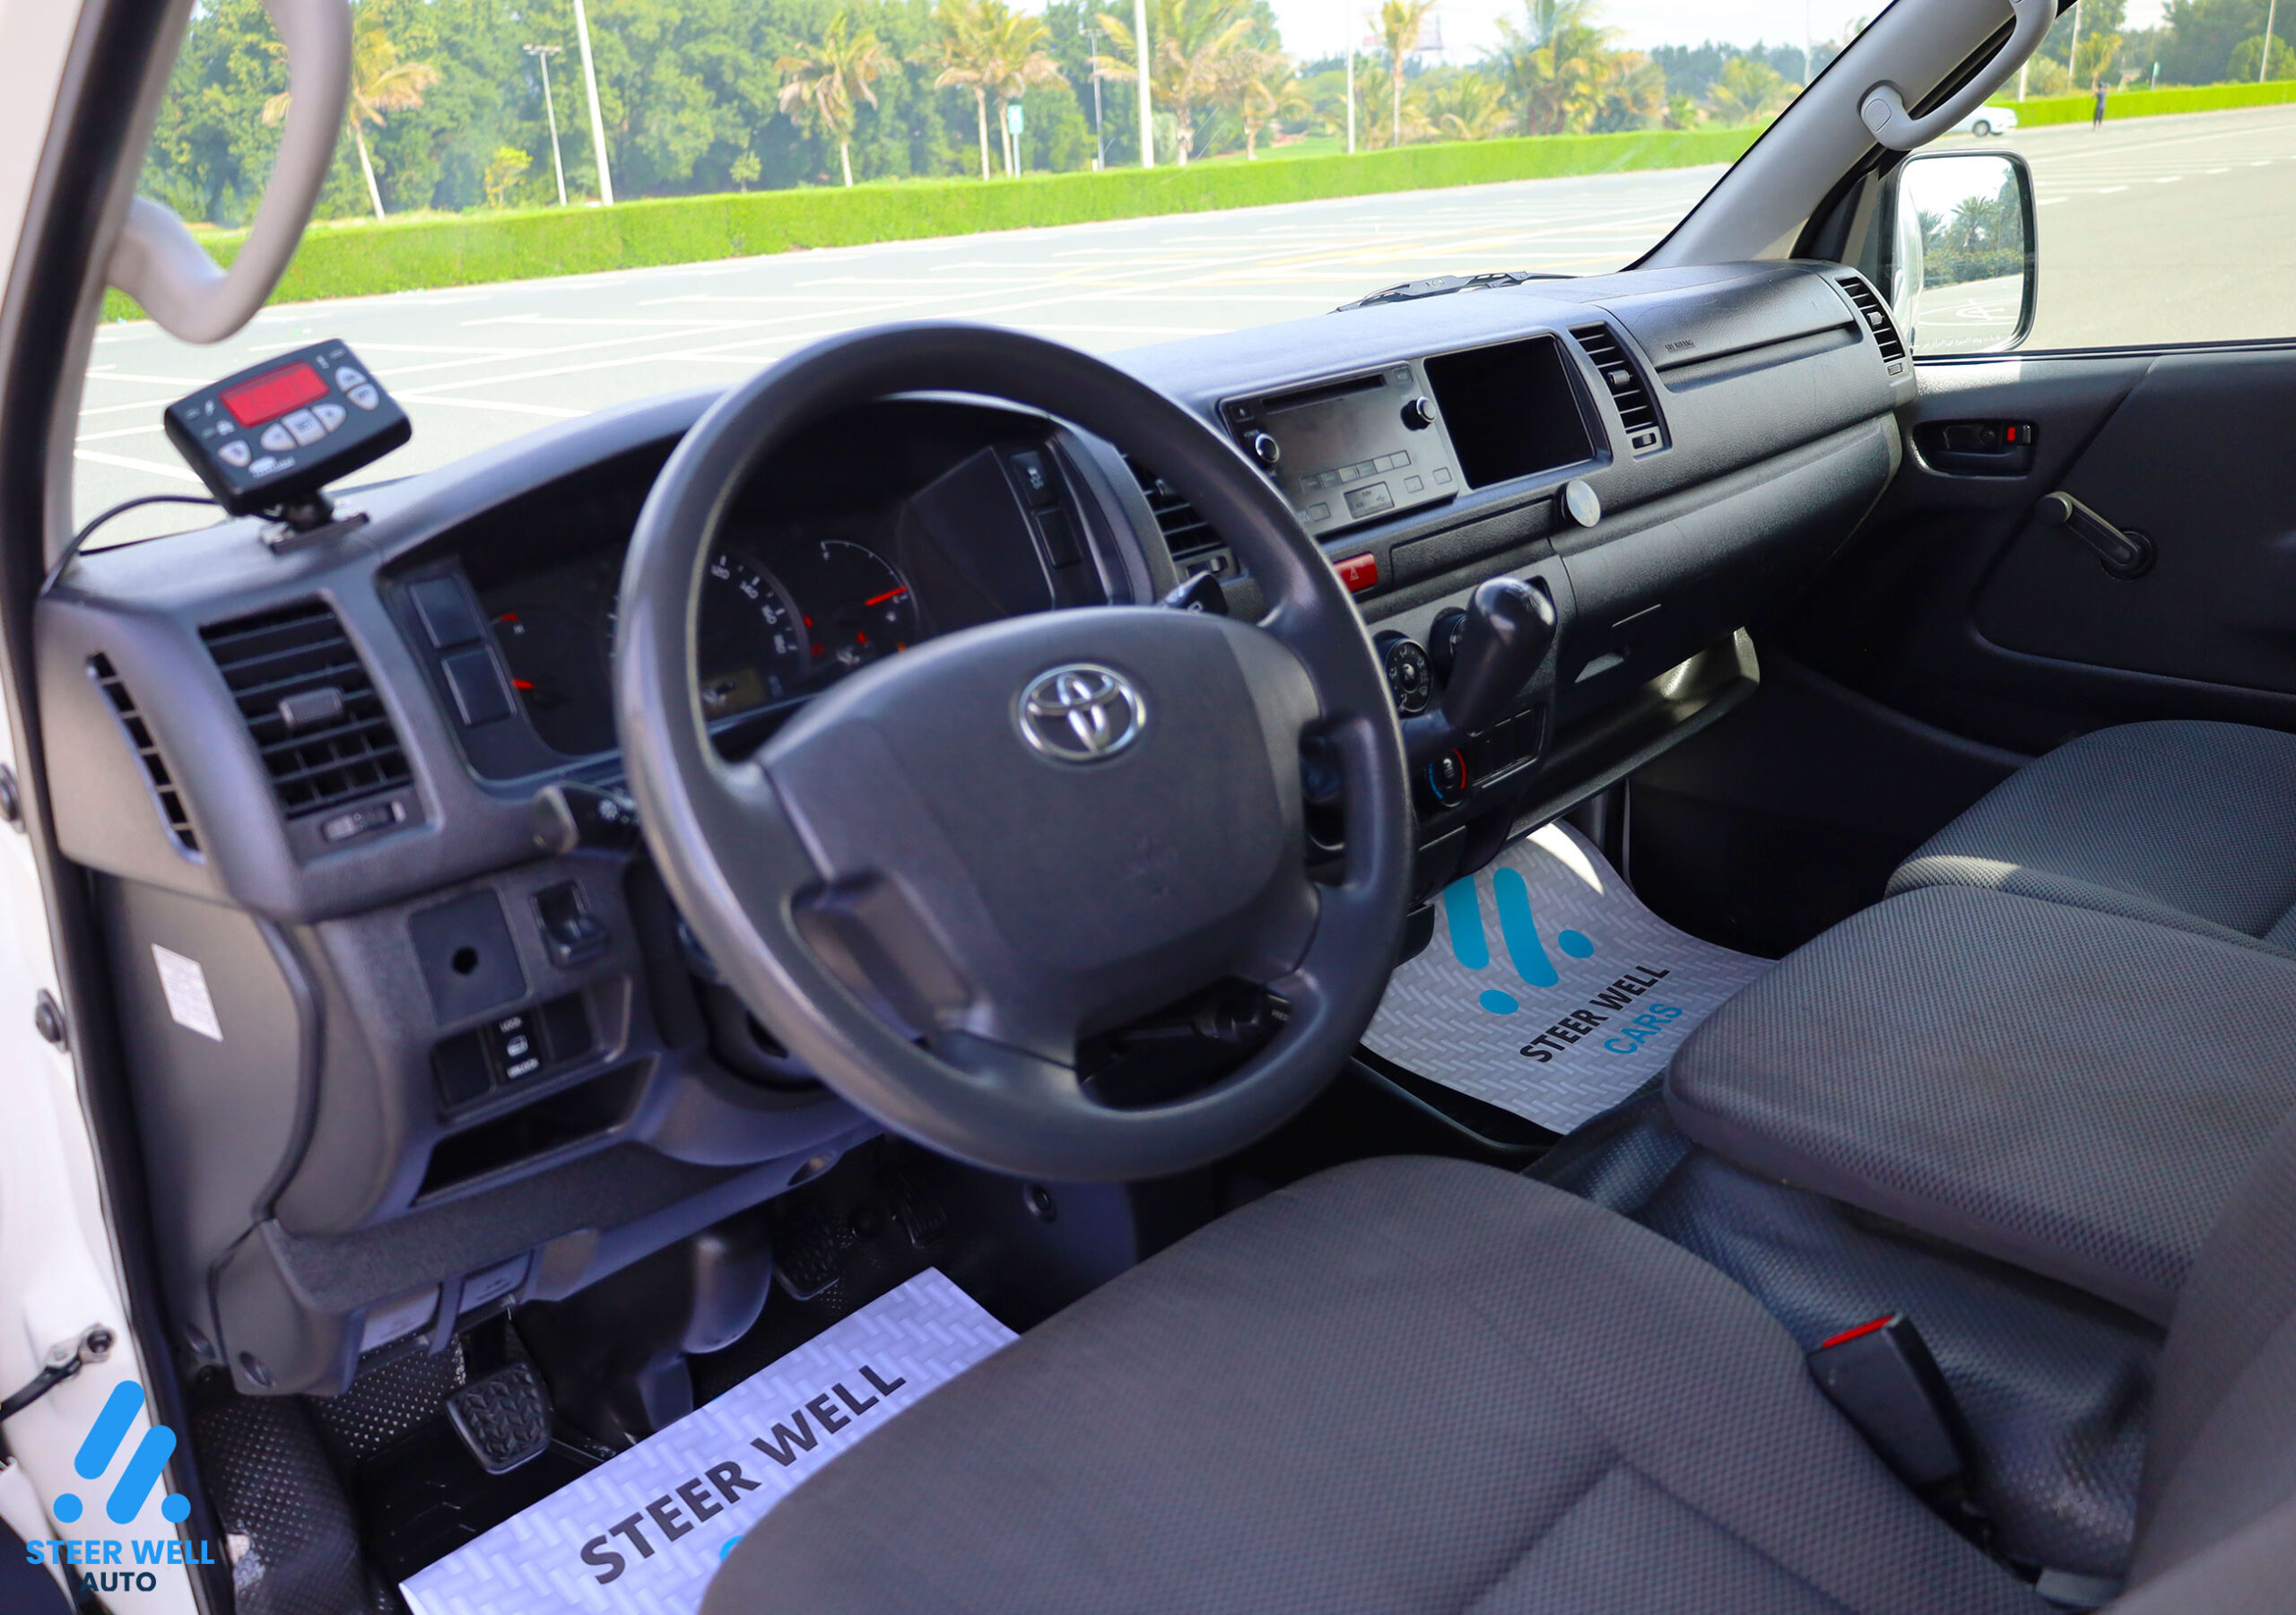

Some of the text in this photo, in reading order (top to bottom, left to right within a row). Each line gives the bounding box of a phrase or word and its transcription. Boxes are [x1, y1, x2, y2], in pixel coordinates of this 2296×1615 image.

[761, 604, 778, 625] 160
[1519, 965, 1672, 1064] STEER WELL
[1604, 1003, 1683, 1055] CARS
[579, 1364, 907, 1585] STEER WELL
